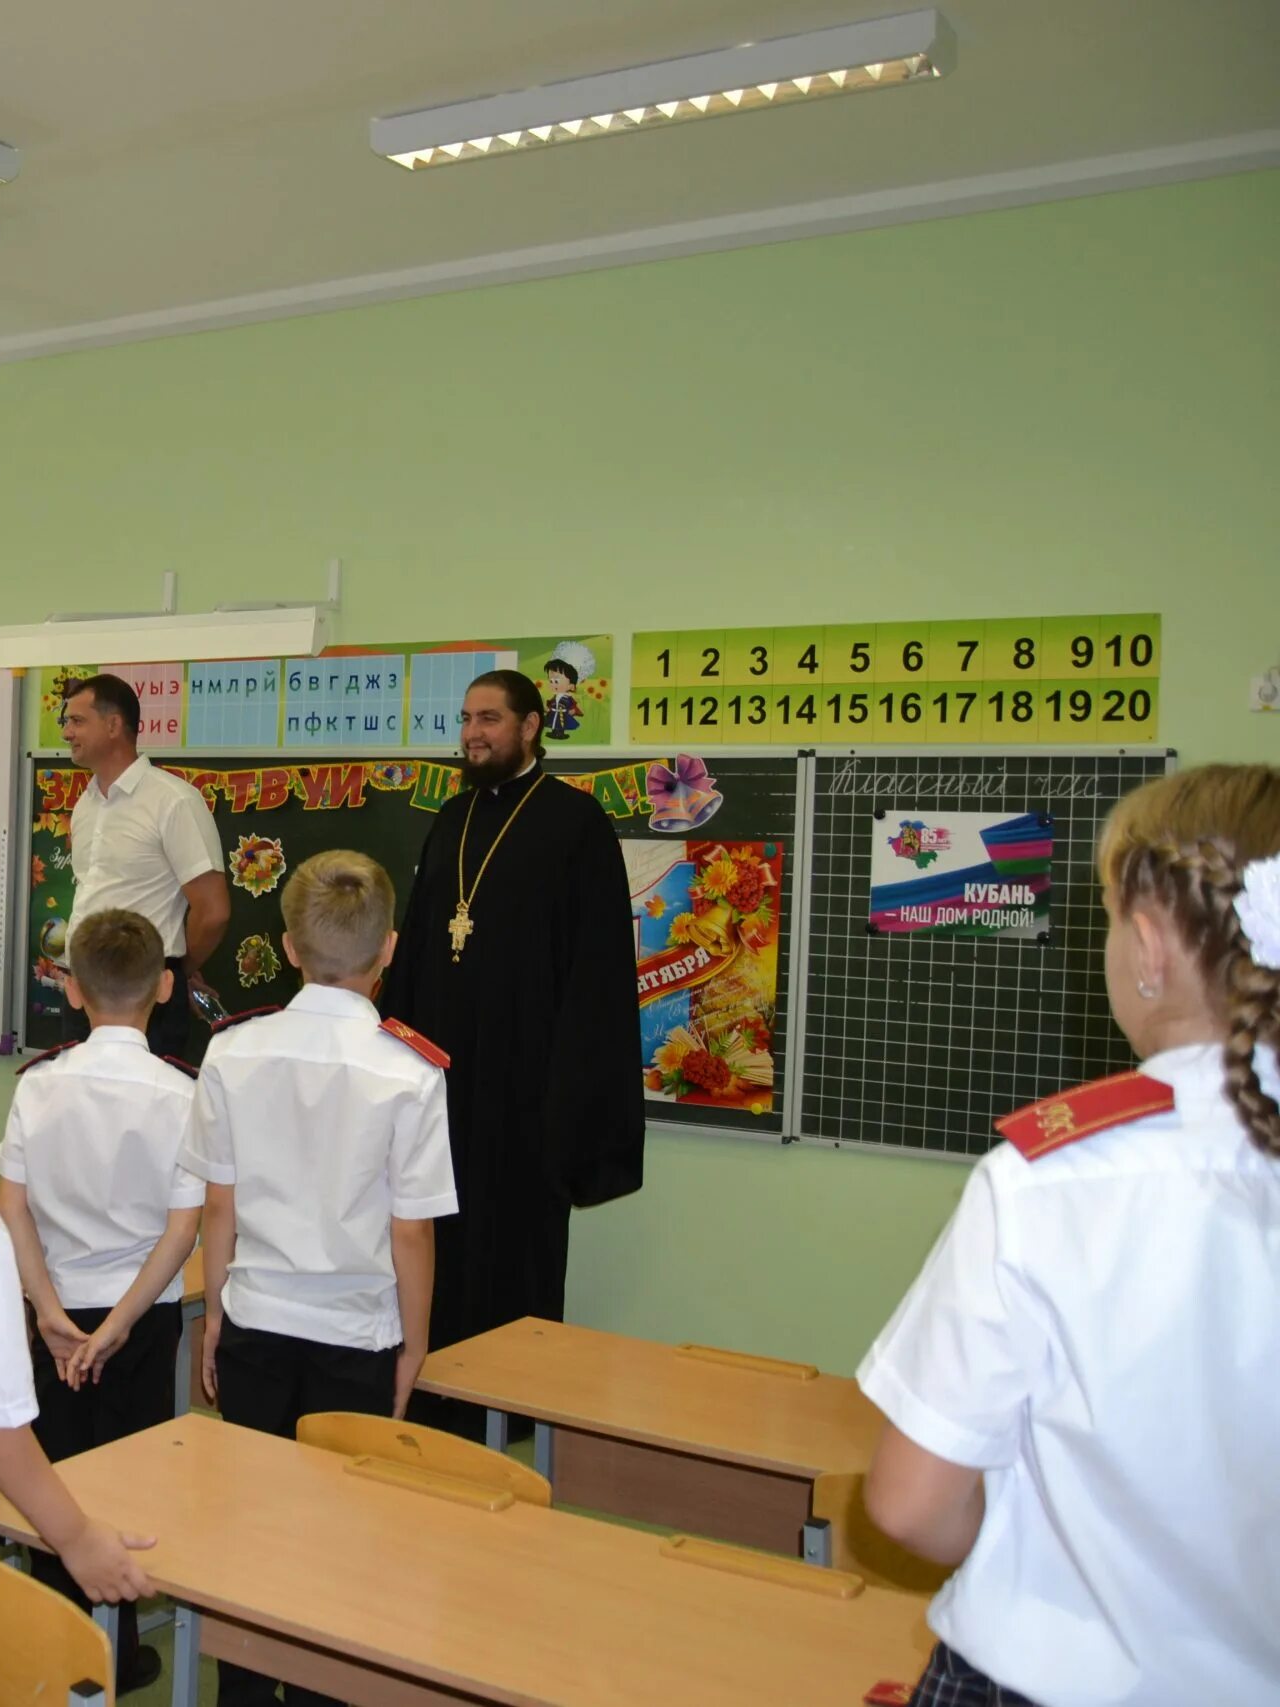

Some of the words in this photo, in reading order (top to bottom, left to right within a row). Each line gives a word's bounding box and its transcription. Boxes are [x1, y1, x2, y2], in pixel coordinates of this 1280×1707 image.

[657, 649, 670, 678] 1
[701, 647, 720, 677] 2
[749, 646, 768, 676] 3
[797, 644, 819, 674] 4
[850, 642, 870, 673] 5
[902, 640, 924, 672] 6
[957, 640, 979, 672] 7
[1013, 637, 1035, 670] 8
[1071, 635, 1094, 669] 9
[1105, 634, 1153, 667] 10
[637, 697, 668, 726] 11
[680, 696, 719, 726] 12
[728, 695, 767, 725] 13
[776, 694, 817, 725] 14
[827, 693, 869, 724] 15
[879, 692, 922, 724] 16
[933, 692, 977, 723] 17
[988, 690, 1033, 723] 18
[1045, 689, 1092, 722] 19
[1102, 689, 1151, 722] 20
[921, 828, 937, 843] 85
[963, 883, 1036, 906] КУБАНЬ
[900, 905, 932, 923] НАШ
[934, 907, 968, 927] ДОМ
[971, 906, 1035, 929] РОДНОЙ!
